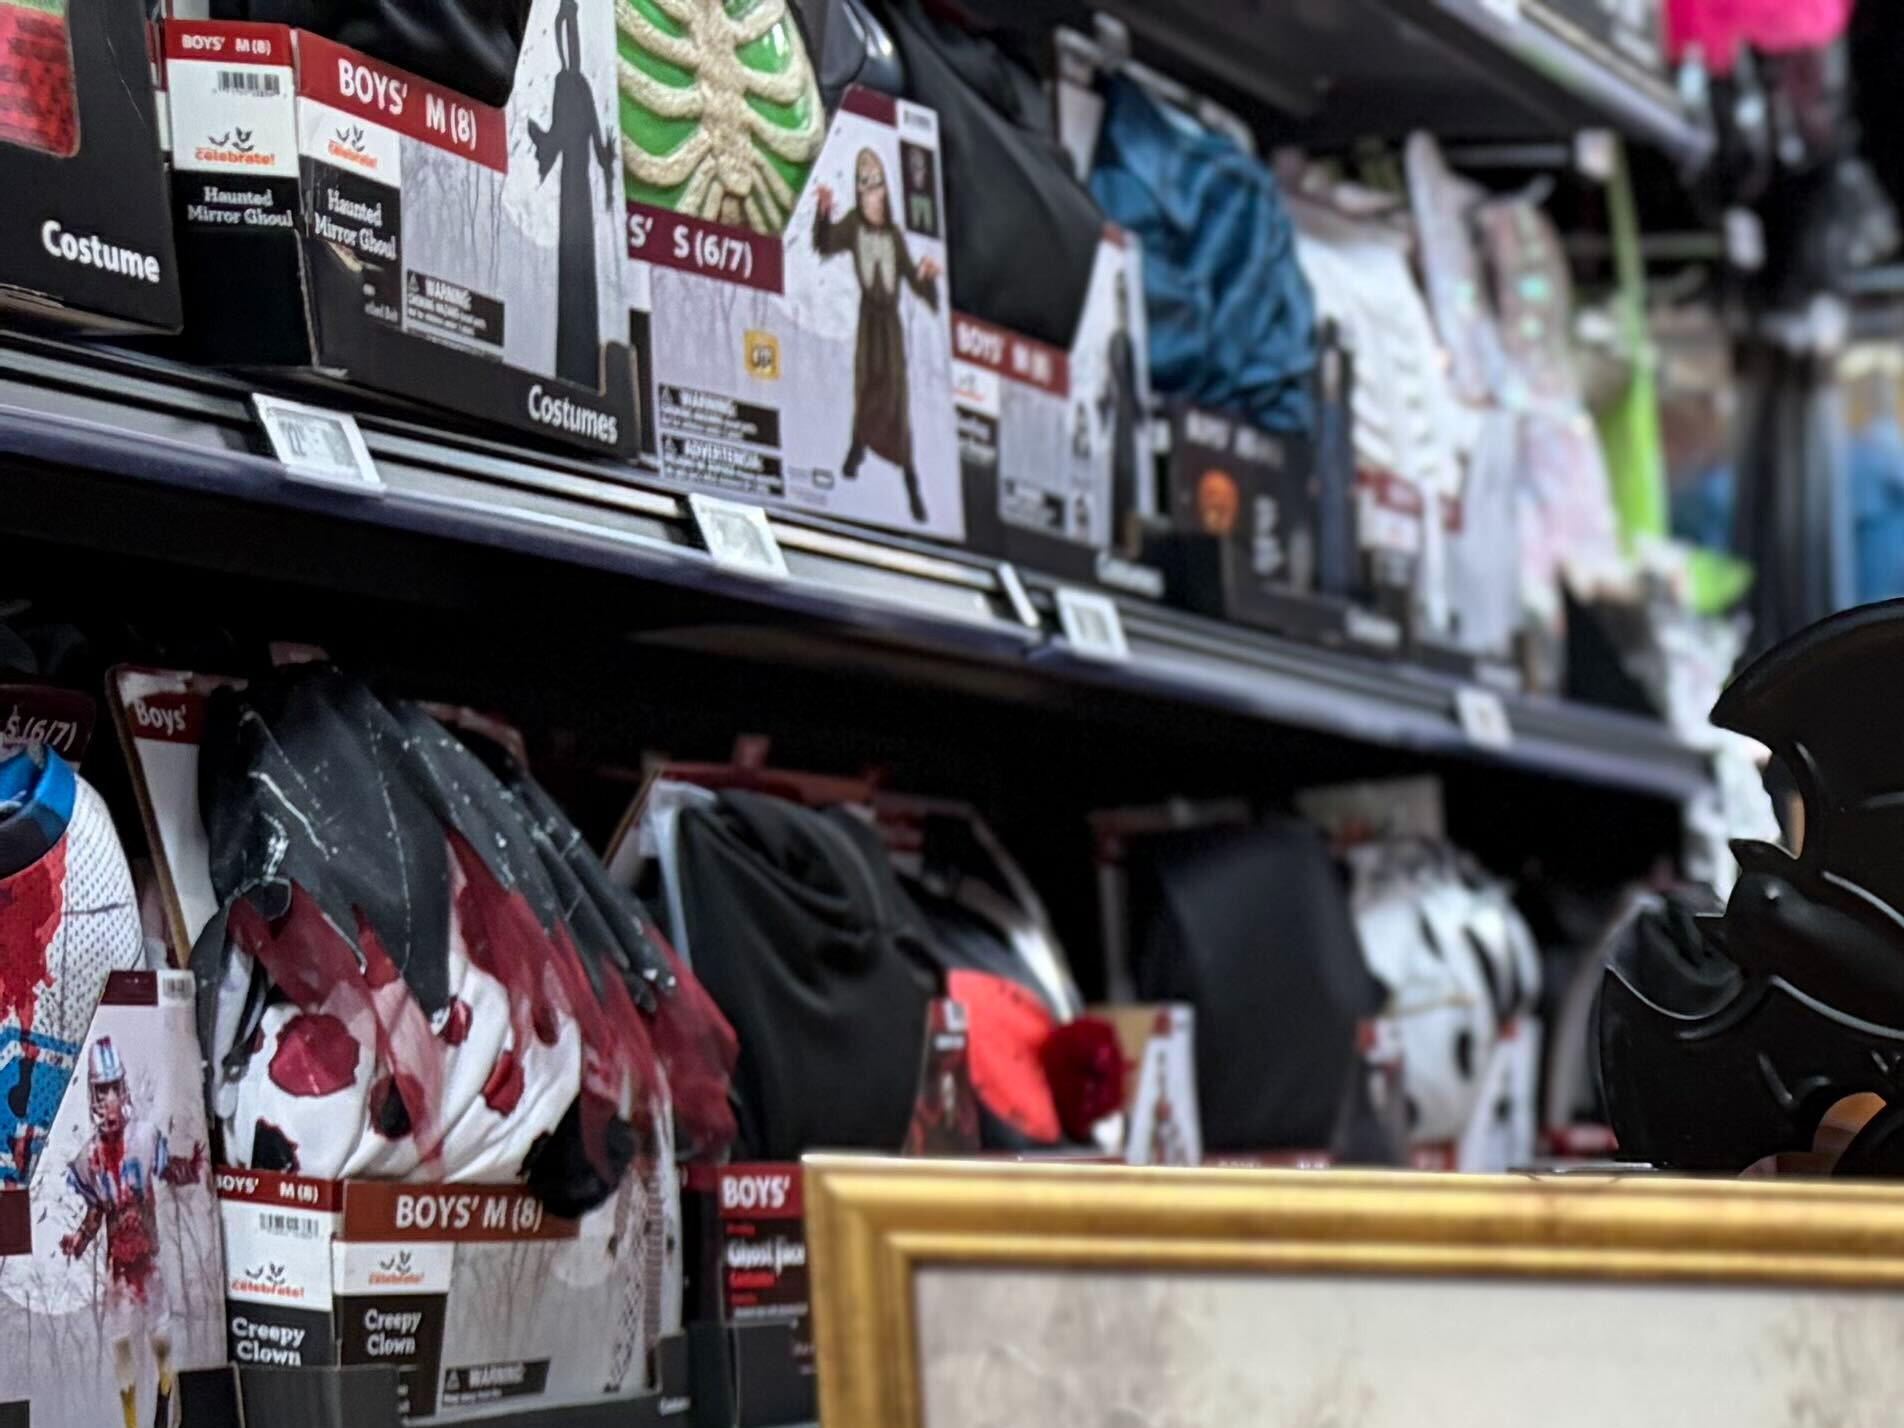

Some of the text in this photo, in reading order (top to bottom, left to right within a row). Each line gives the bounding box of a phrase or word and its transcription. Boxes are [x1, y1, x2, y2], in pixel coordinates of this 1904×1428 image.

[182, 34, 225, 51] BOYS'
[235, 38, 250, 52] M
[337, 58, 477, 150] BOYS' M (8)
[203, 185, 274, 208] Haunted
[327, 187, 383, 227] Haunted
[187, 204, 294, 228] Mirror Ghoul
[41, 219, 161, 284] Costume
[314, 211, 397, 260] Mirror Ghoul
[672, 226, 691, 259] S
[695, 230, 753, 280] (6/7)
[528, 384, 618, 445] Costumes
[21, 716, 77, 752] (6/7)
[135, 702, 187, 735] Boys'
[279, 1181, 295, 1199] M
[722, 1174, 790, 1209] BOYS'
[395, 1194, 544, 1234] BOYS' M (8)
[231, 1317, 306, 1349] Creepy
[364, 1308, 423, 1334] Creepy
[236, 1341, 302, 1368] Clown
[366, 1334, 417, 1357] Clown
